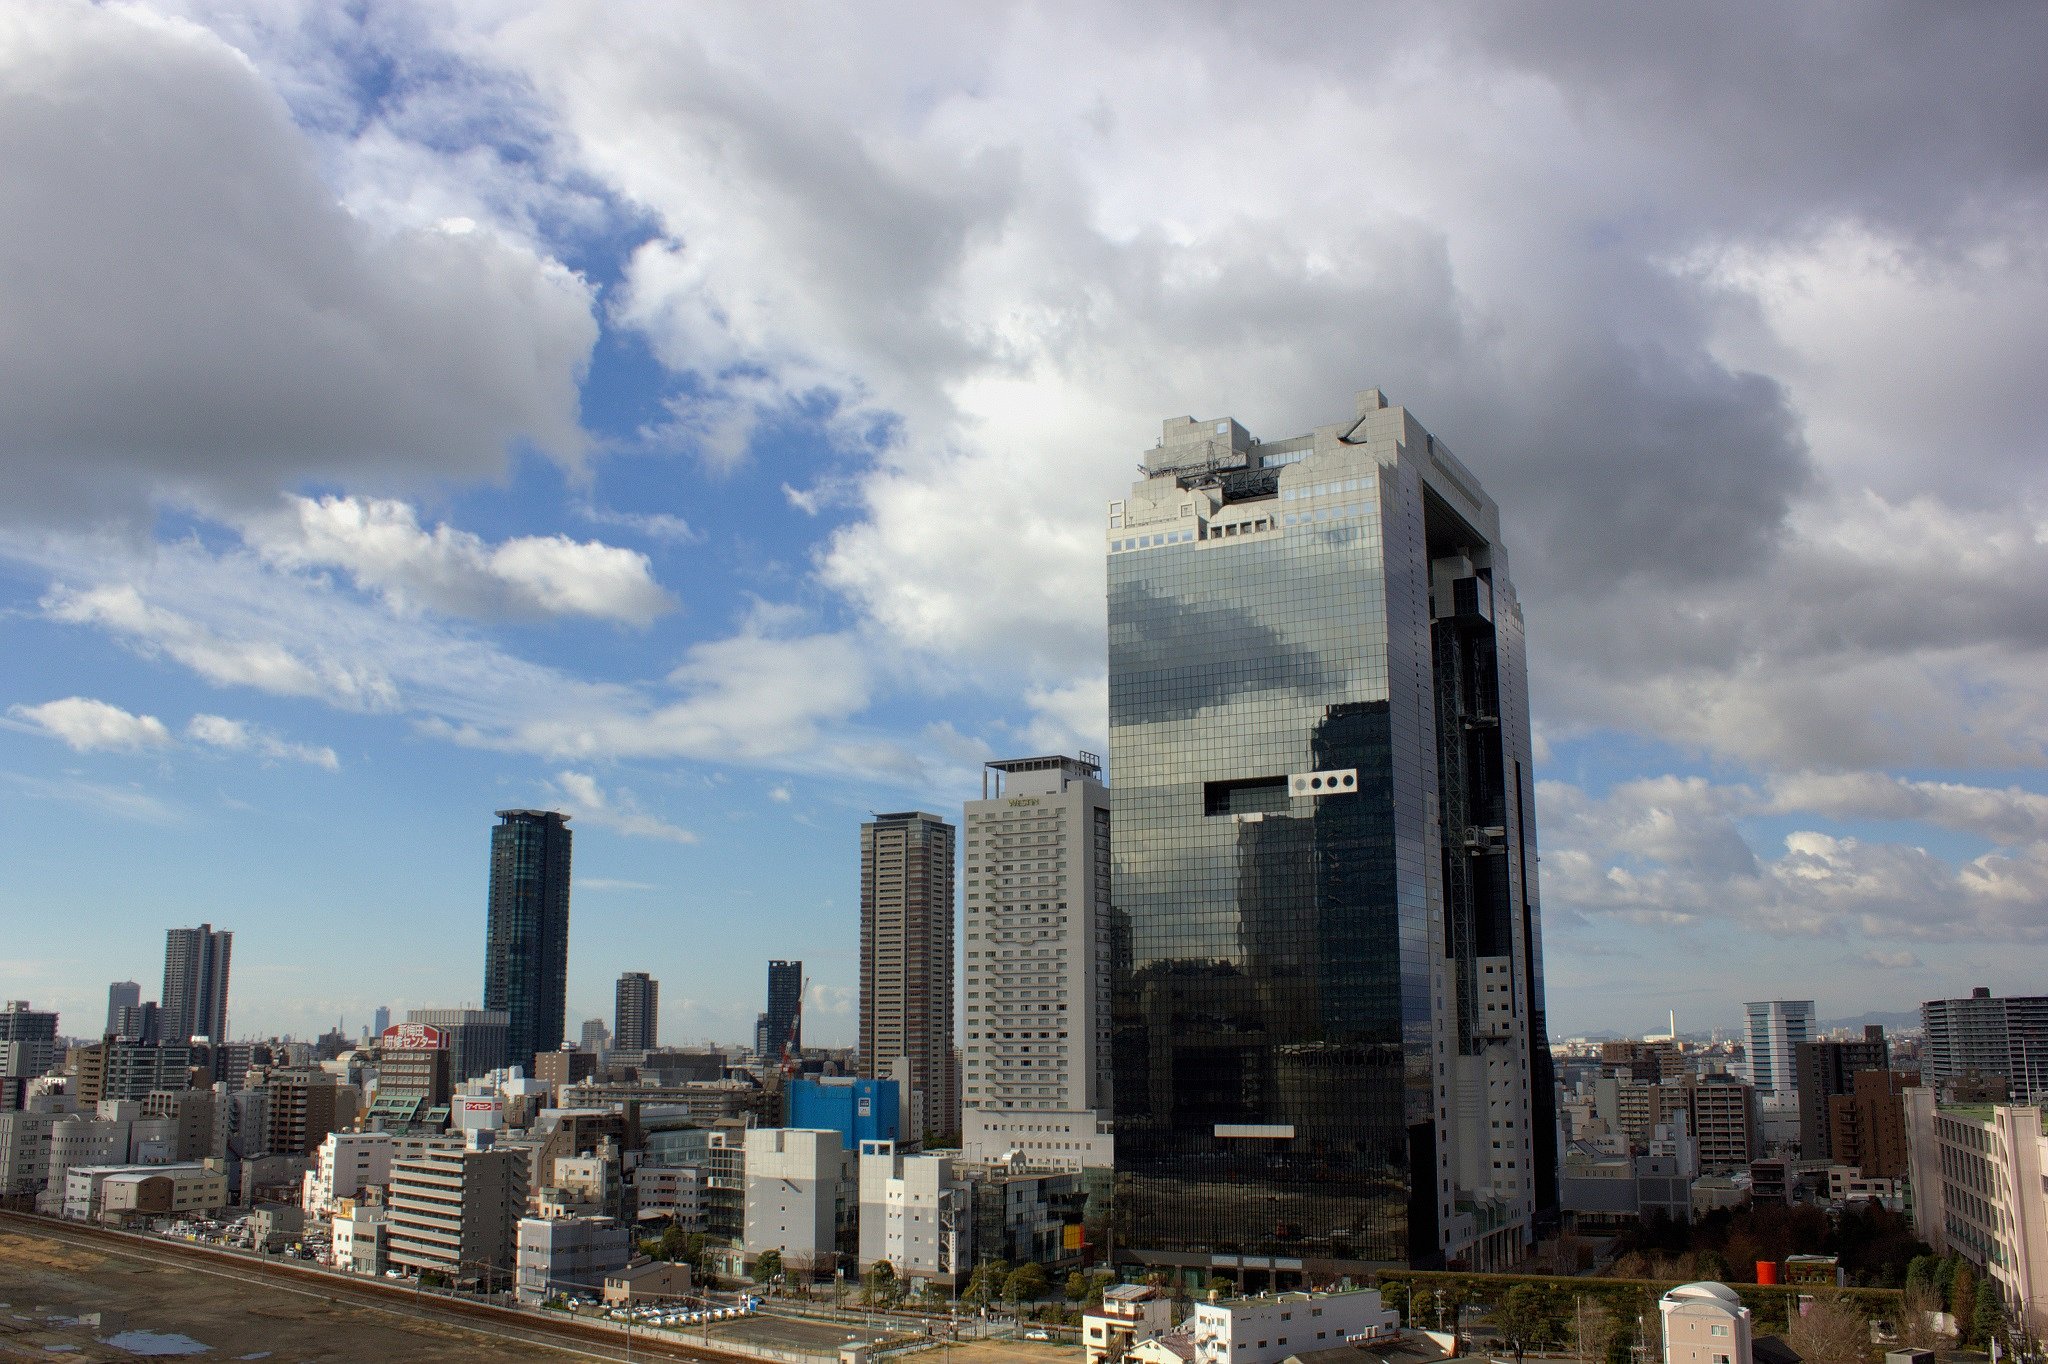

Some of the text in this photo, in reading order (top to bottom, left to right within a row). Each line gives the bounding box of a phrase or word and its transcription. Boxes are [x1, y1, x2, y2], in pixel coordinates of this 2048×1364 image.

[1008, 798, 1040, 807] WESTIN
[384, 1035, 437, 1048] 研修センター
